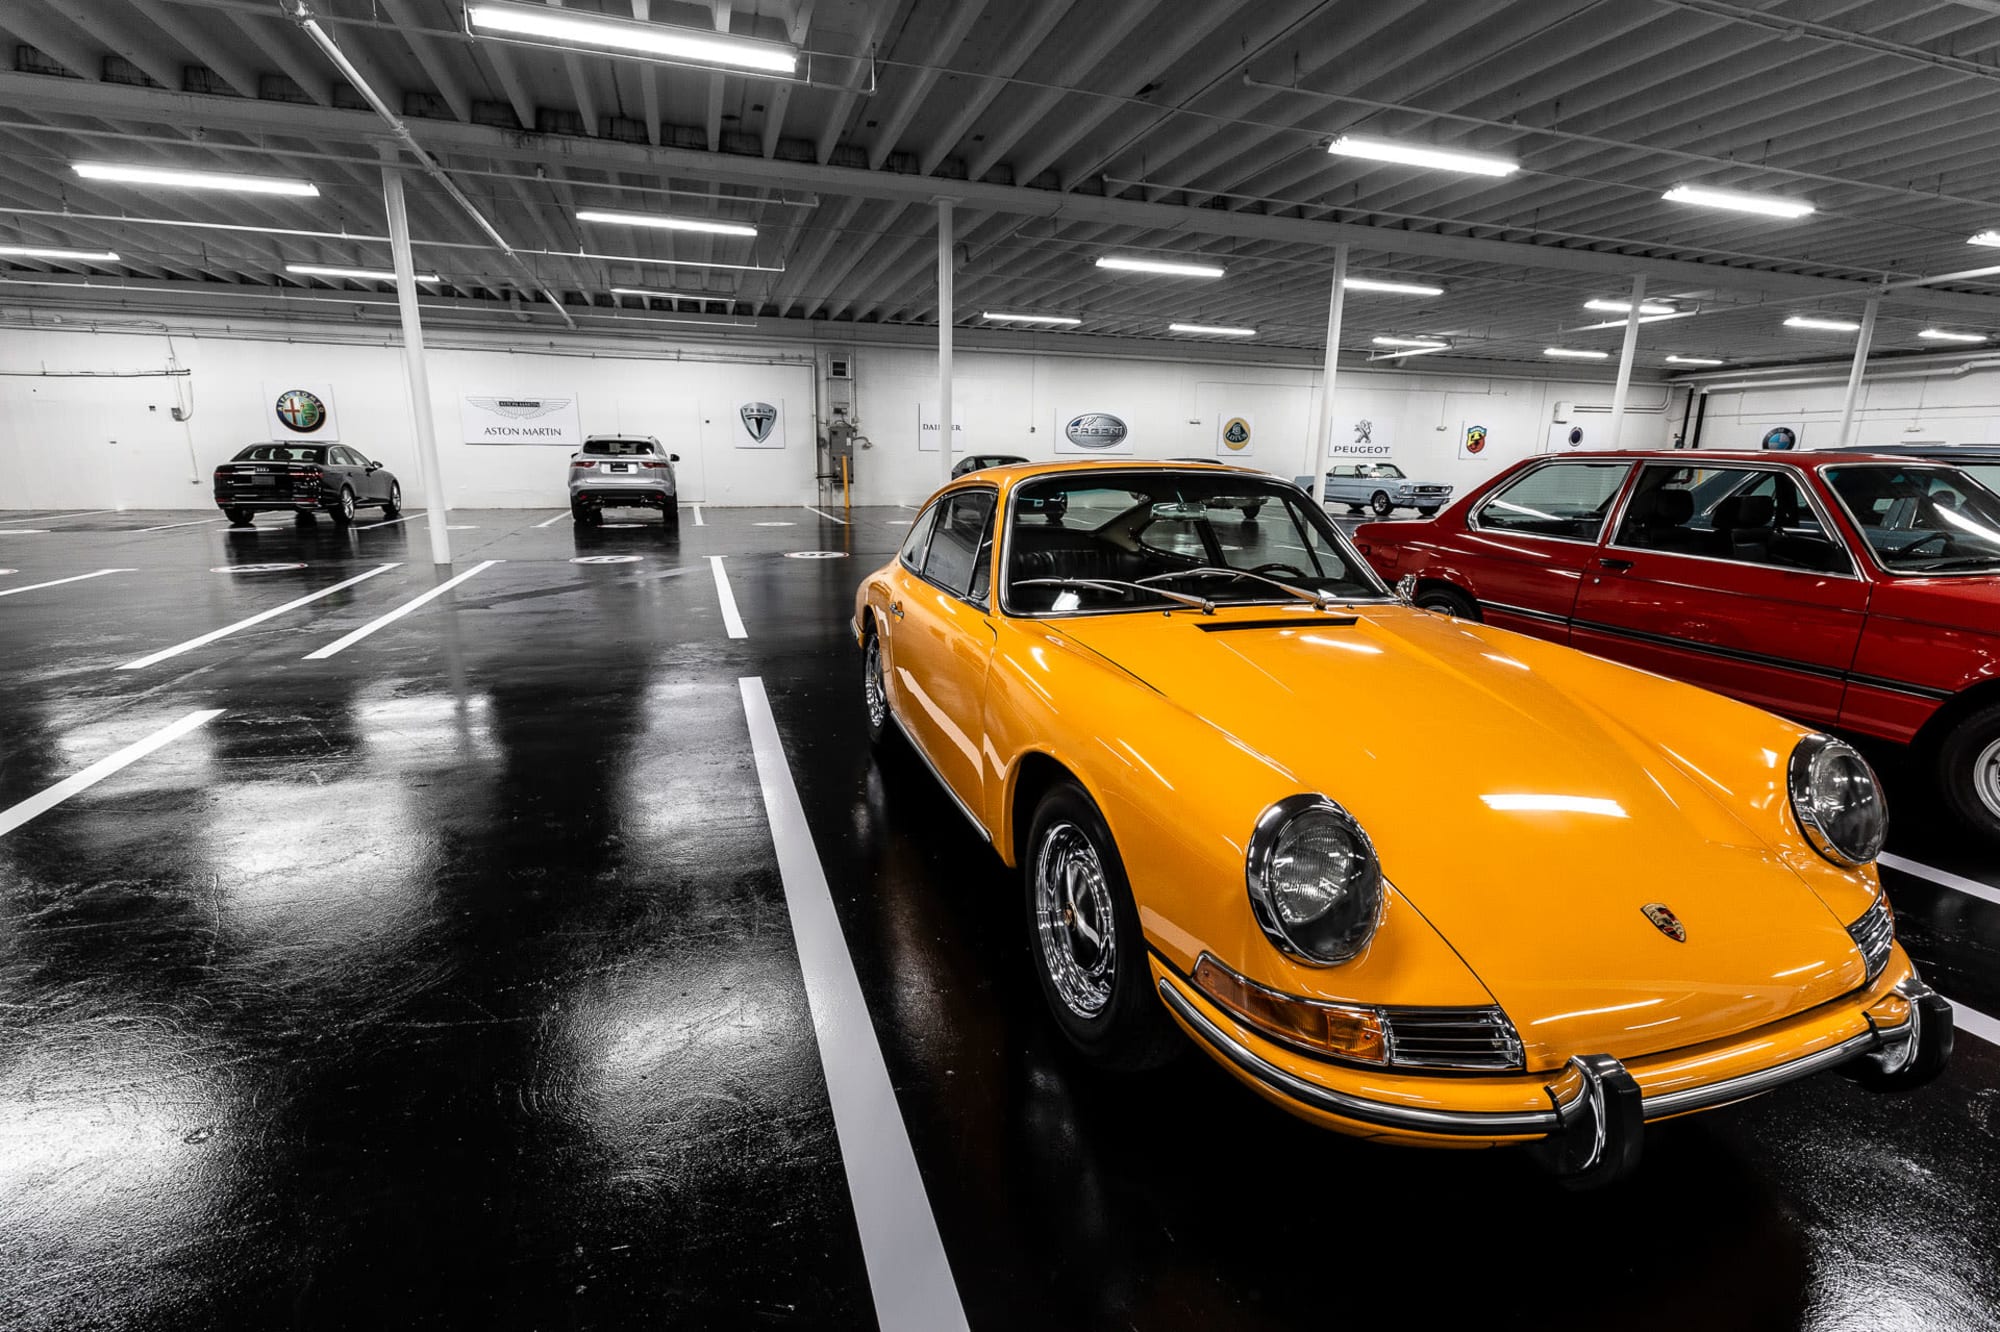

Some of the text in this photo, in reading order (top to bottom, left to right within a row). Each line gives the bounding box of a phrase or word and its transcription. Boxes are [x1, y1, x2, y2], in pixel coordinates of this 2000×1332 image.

[484, 426, 562, 436] ASTON MARTIN
[922, 423, 961, 431] DAIER
[1334, 445, 1390, 454] PEUGEOT
